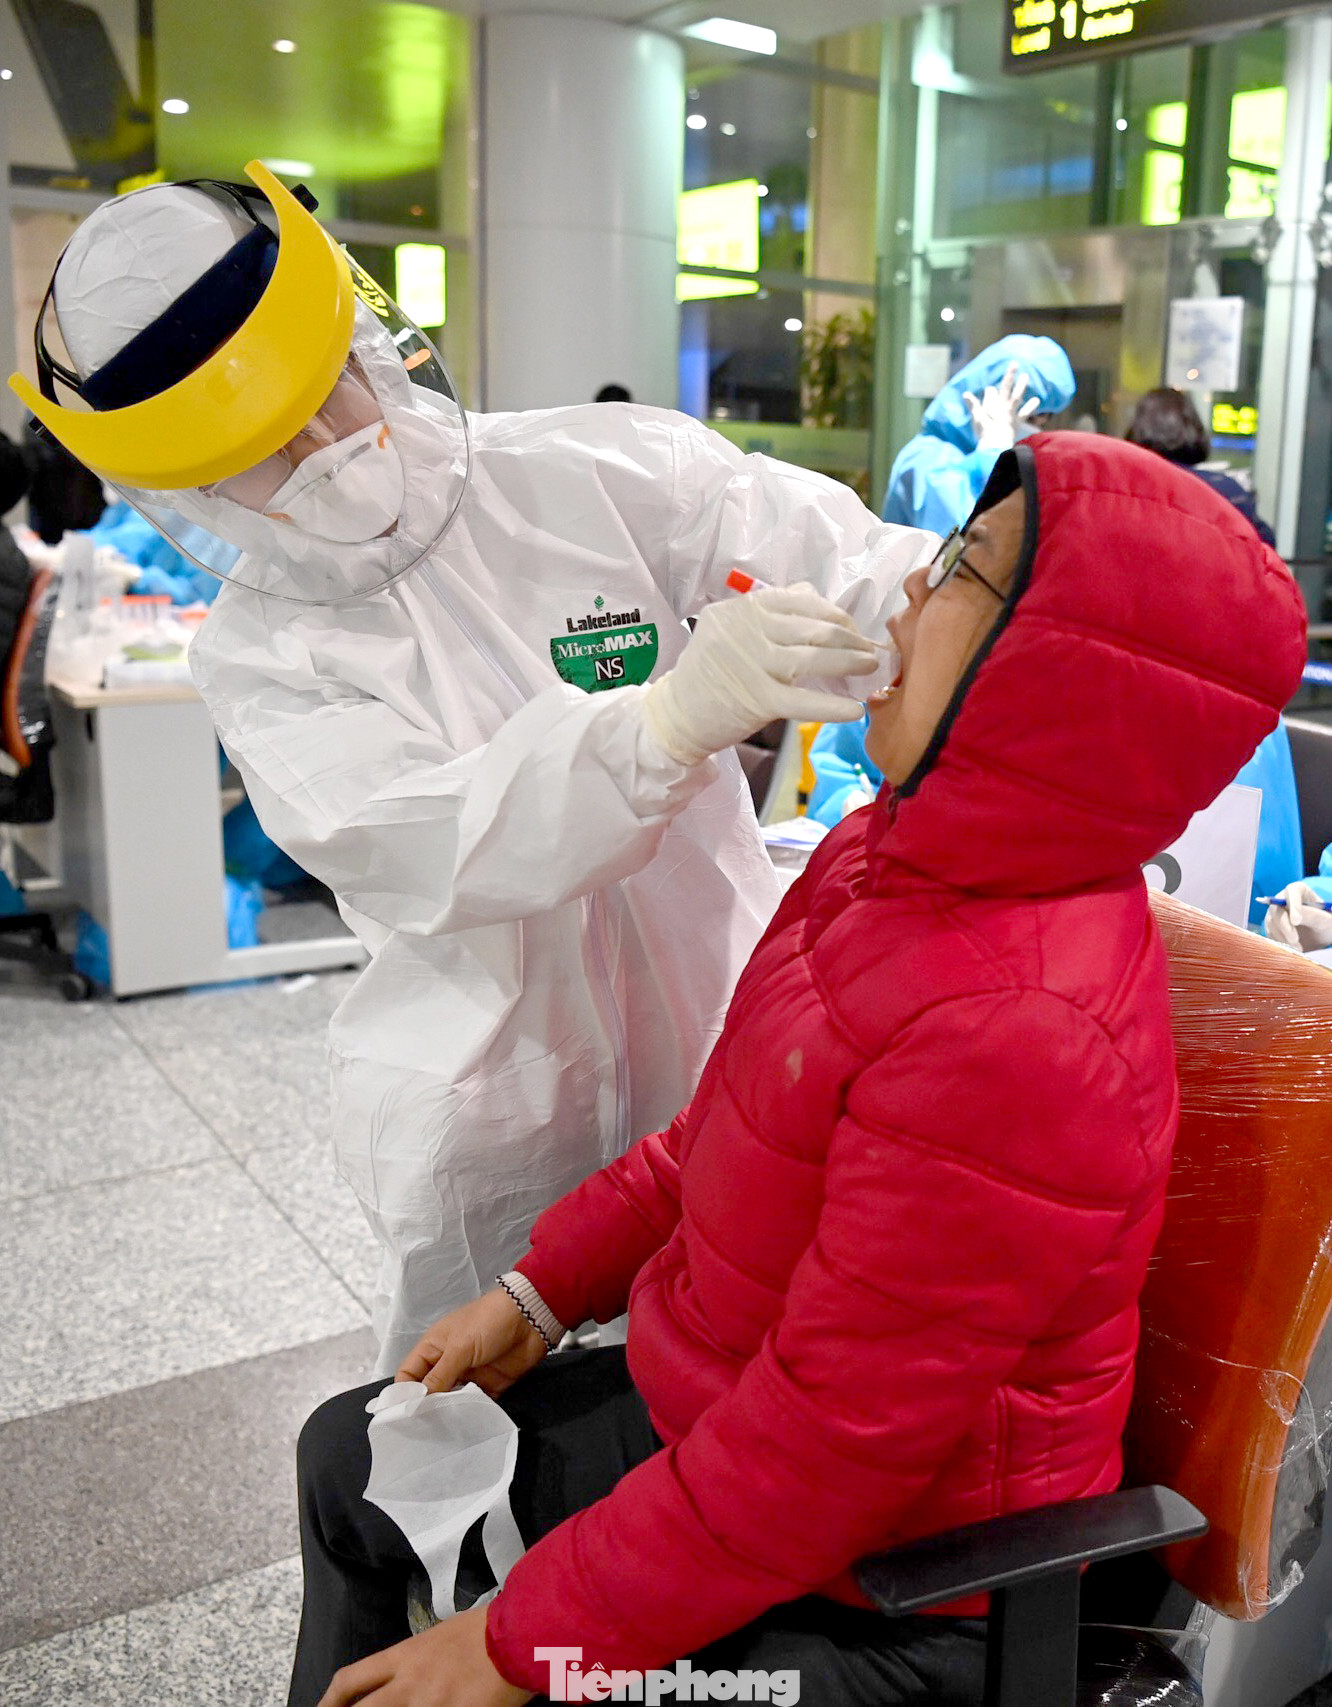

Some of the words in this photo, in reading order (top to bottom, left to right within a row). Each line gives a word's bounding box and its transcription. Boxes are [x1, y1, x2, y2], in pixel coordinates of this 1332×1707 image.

[1060, 0, 1077, 39] 1
[566, 608, 641, 633] Lakeland
[556, 630, 653, 659] MicroMAX
[594, 657, 624, 681] NS
